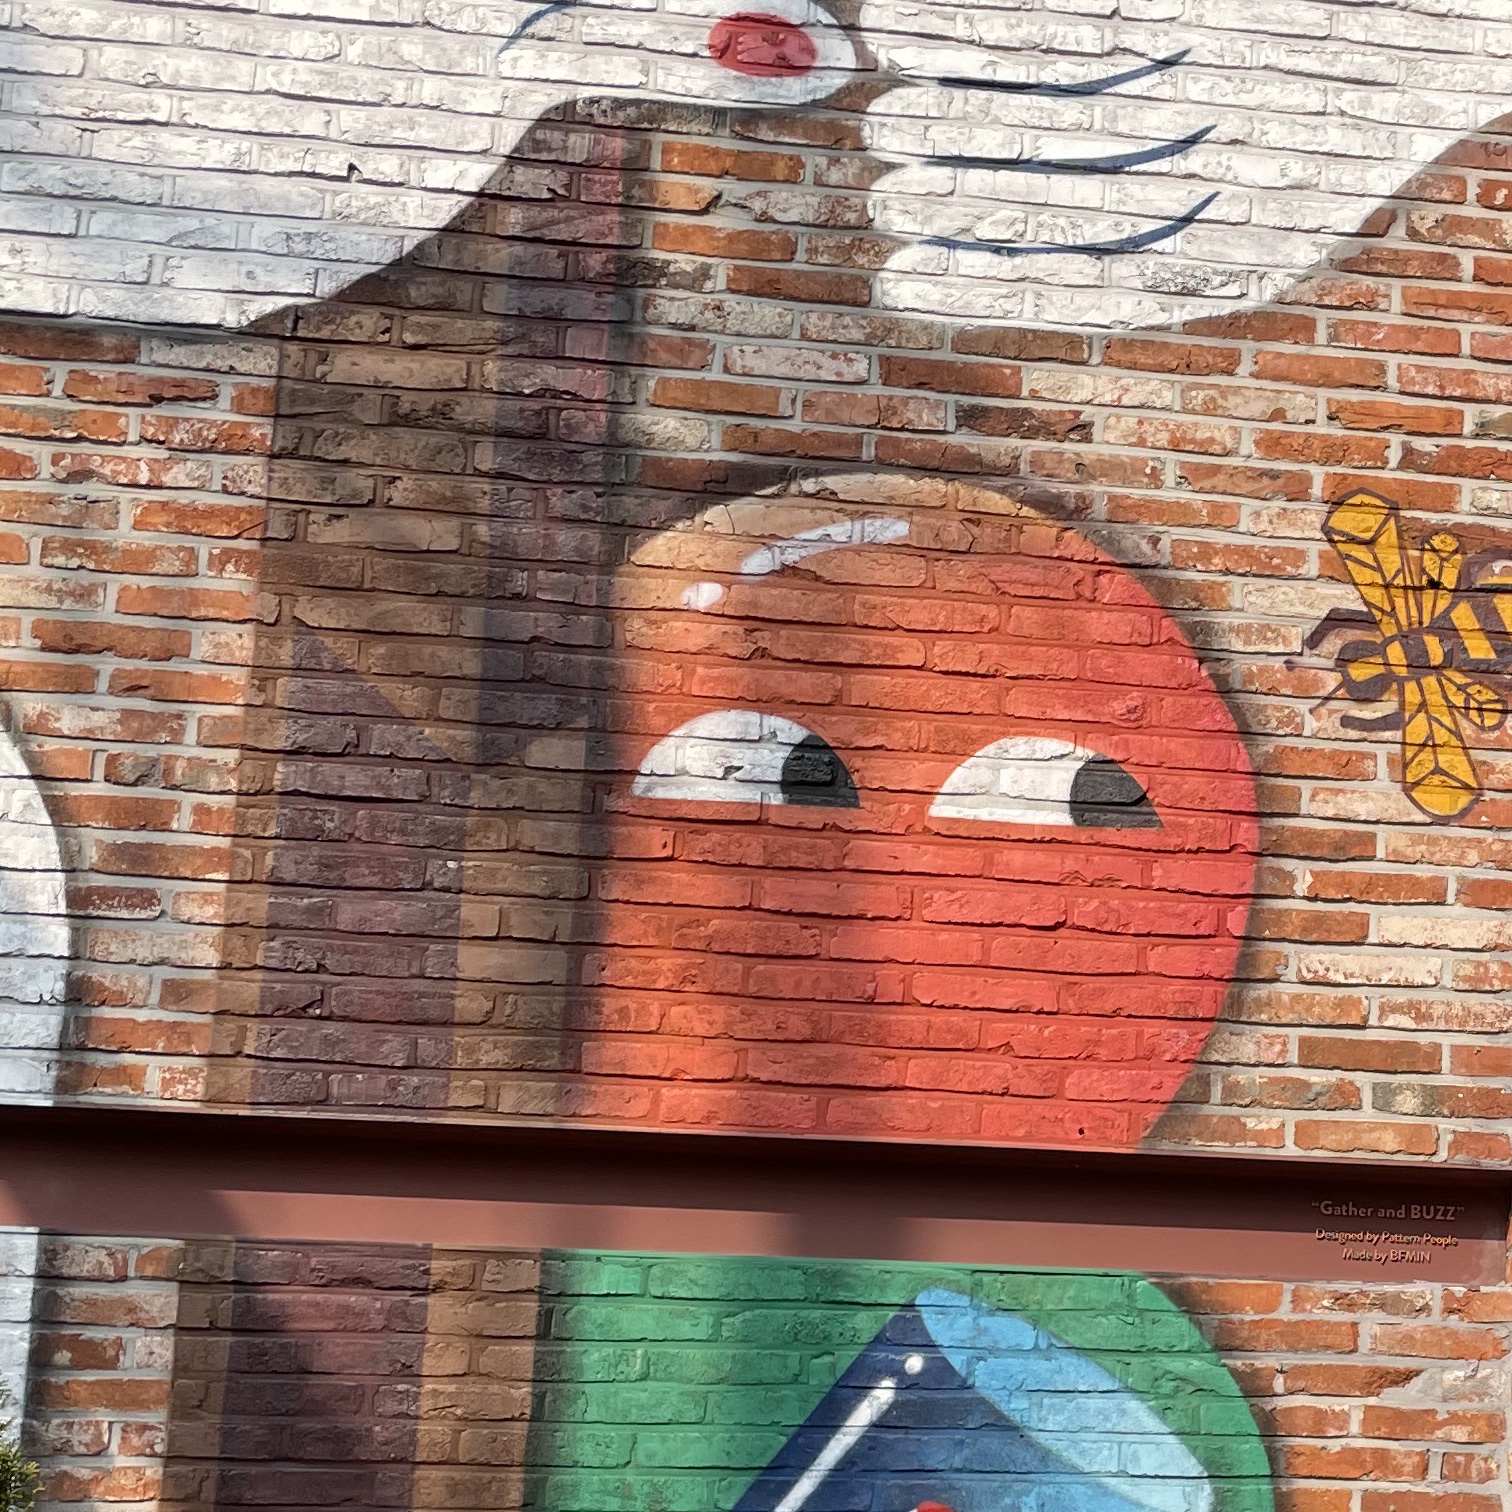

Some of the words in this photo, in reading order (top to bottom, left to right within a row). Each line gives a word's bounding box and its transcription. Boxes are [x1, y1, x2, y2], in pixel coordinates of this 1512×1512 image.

[1377, 1203, 1406, 1219] and
[1315, 1227, 1364, 1245] Designed
[1366, 1230, 1380, 1246] by
[1382, 1231, 1421, 1245] Pattern
[1423, 1233, 1459, 1248] People
[1342, 1247, 1373, 1261] Made
[1374, 1249, 1388, 1265] by
